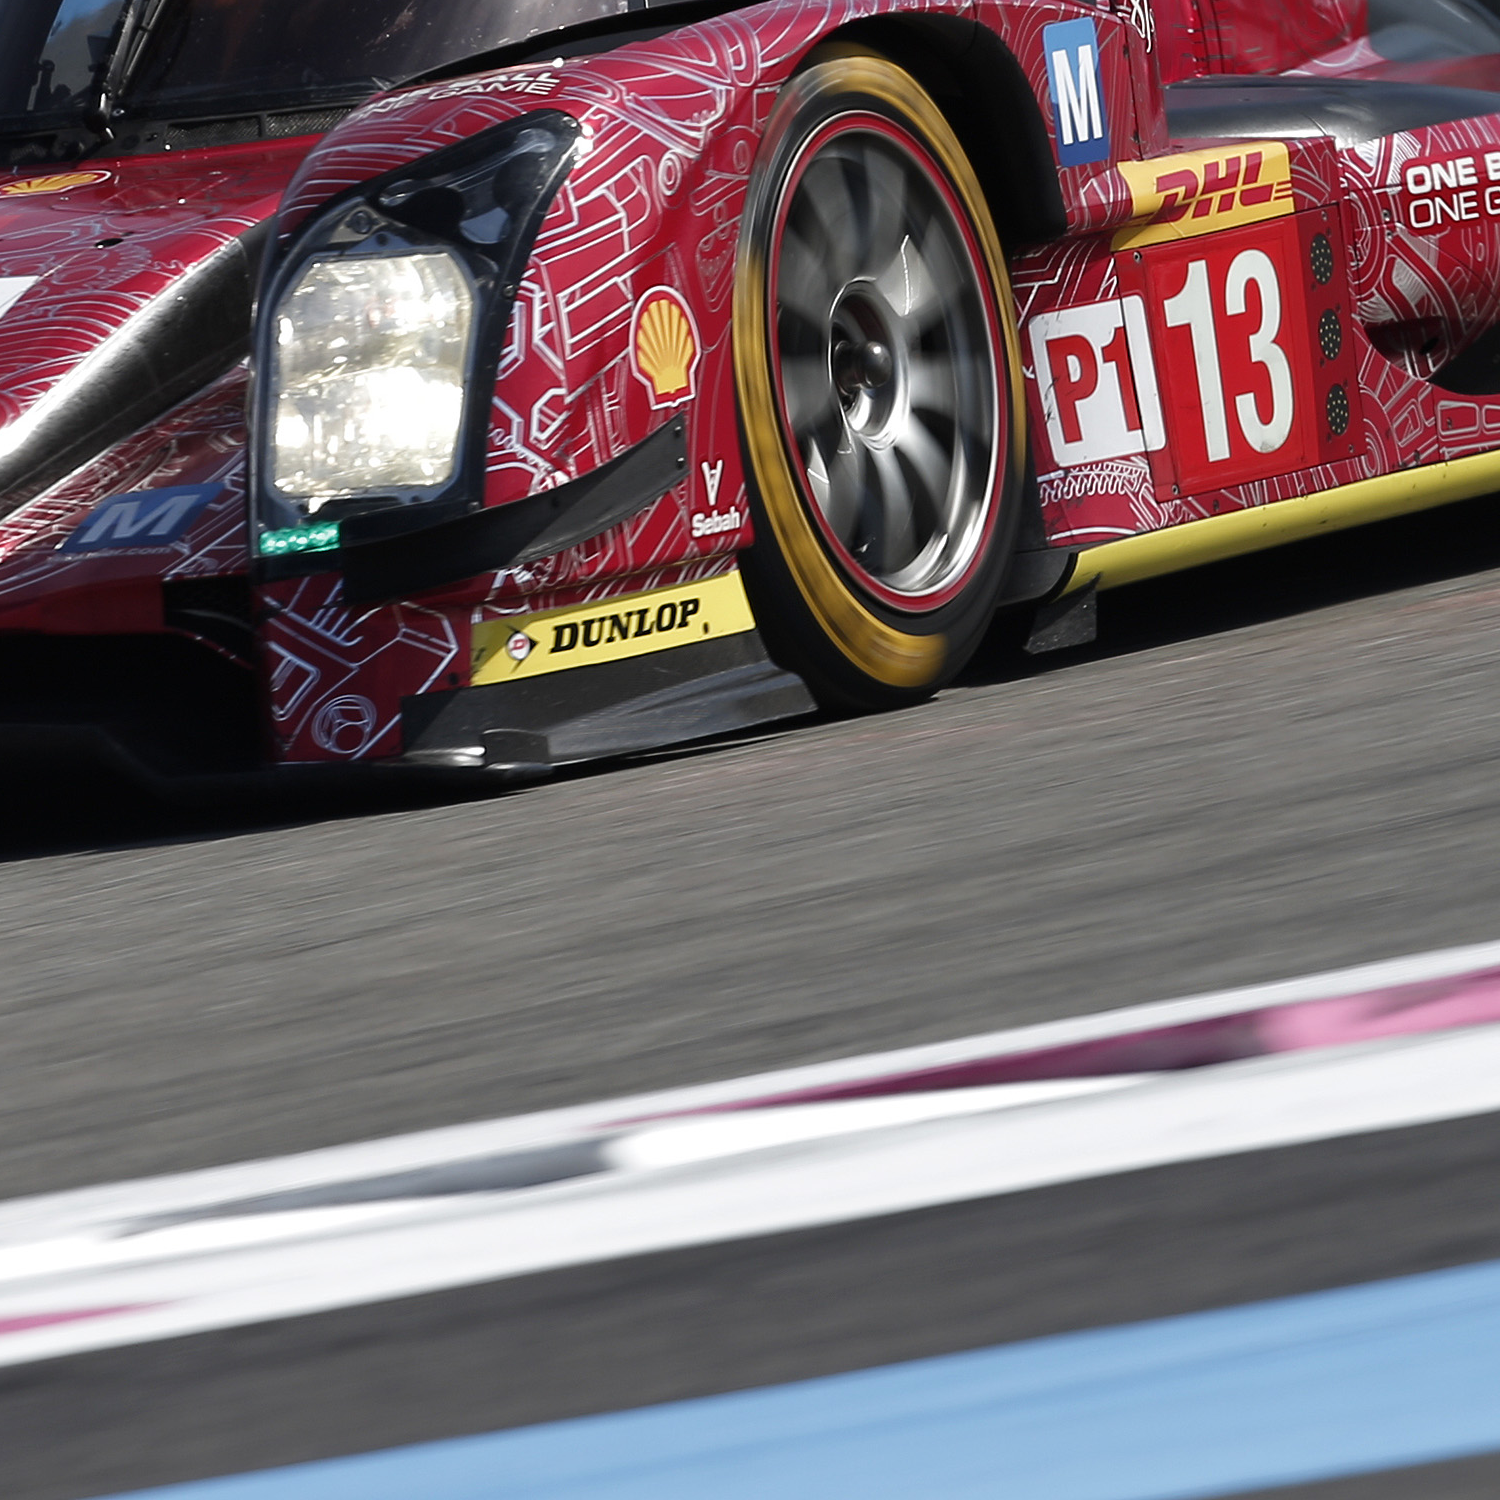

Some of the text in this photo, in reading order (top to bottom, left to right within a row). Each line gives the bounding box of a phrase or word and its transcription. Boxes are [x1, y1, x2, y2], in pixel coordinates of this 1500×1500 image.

[1153, 151, 1273, 224] DHL
[1406, 156, 1479, 195] ONE
[1409, 190, 1480, 229] ONE
[1164, 249, 1294, 462] 13
[1045, 327, 1143, 444] P1
[691, 506, 741, 538] Sebah
[550, 598, 700, 654] DUNLOP
